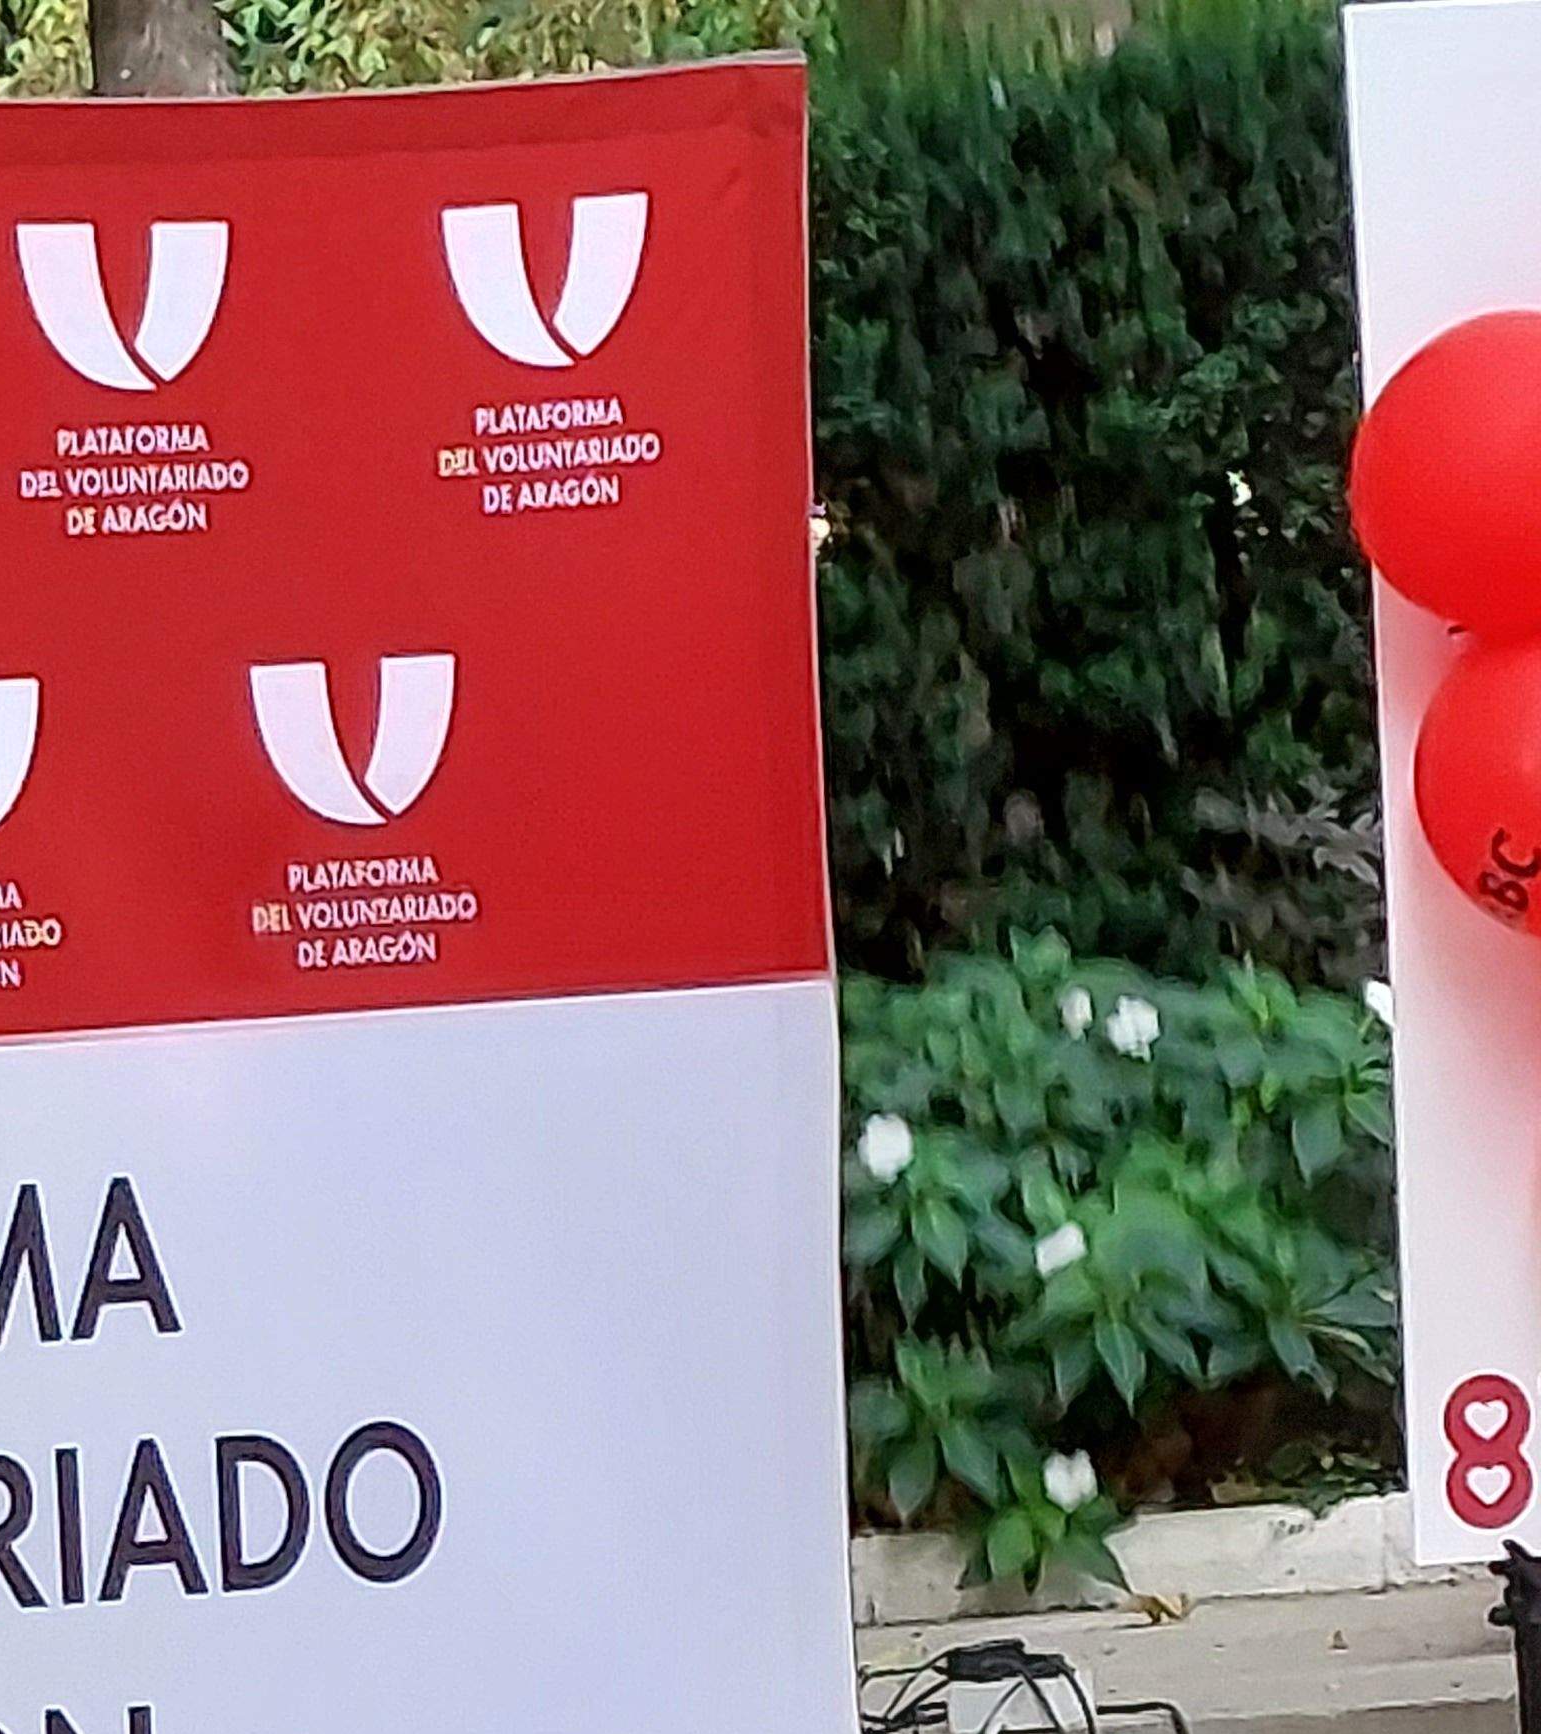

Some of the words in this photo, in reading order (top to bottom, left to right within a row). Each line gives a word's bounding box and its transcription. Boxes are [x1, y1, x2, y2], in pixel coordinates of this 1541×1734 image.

[474, 397, 624, 436] PLATAFORMA
[56, 423, 211, 458] PLATAFORMA
[437, 446, 480, 478] DEL
[481, 431, 661, 475] VOLUNTARIADO
[19, 469, 64, 499] DEL
[63, 460, 250, 497] VOLUNTARIADO
[481, 482, 514, 514] DE
[516, 473, 620, 511] ARAGÓN
[65, 505, 98, 536] DE
[100, 497, 208, 534] ARAGÓN
[287, 855, 440, 893] PLATAFORMA
[251, 902, 293, 934] DEL
[295, 891, 478, 931] VOLUNTARIADO
[297, 938, 329, 969] DE
[330, 929, 437, 966] ARAGÓN
